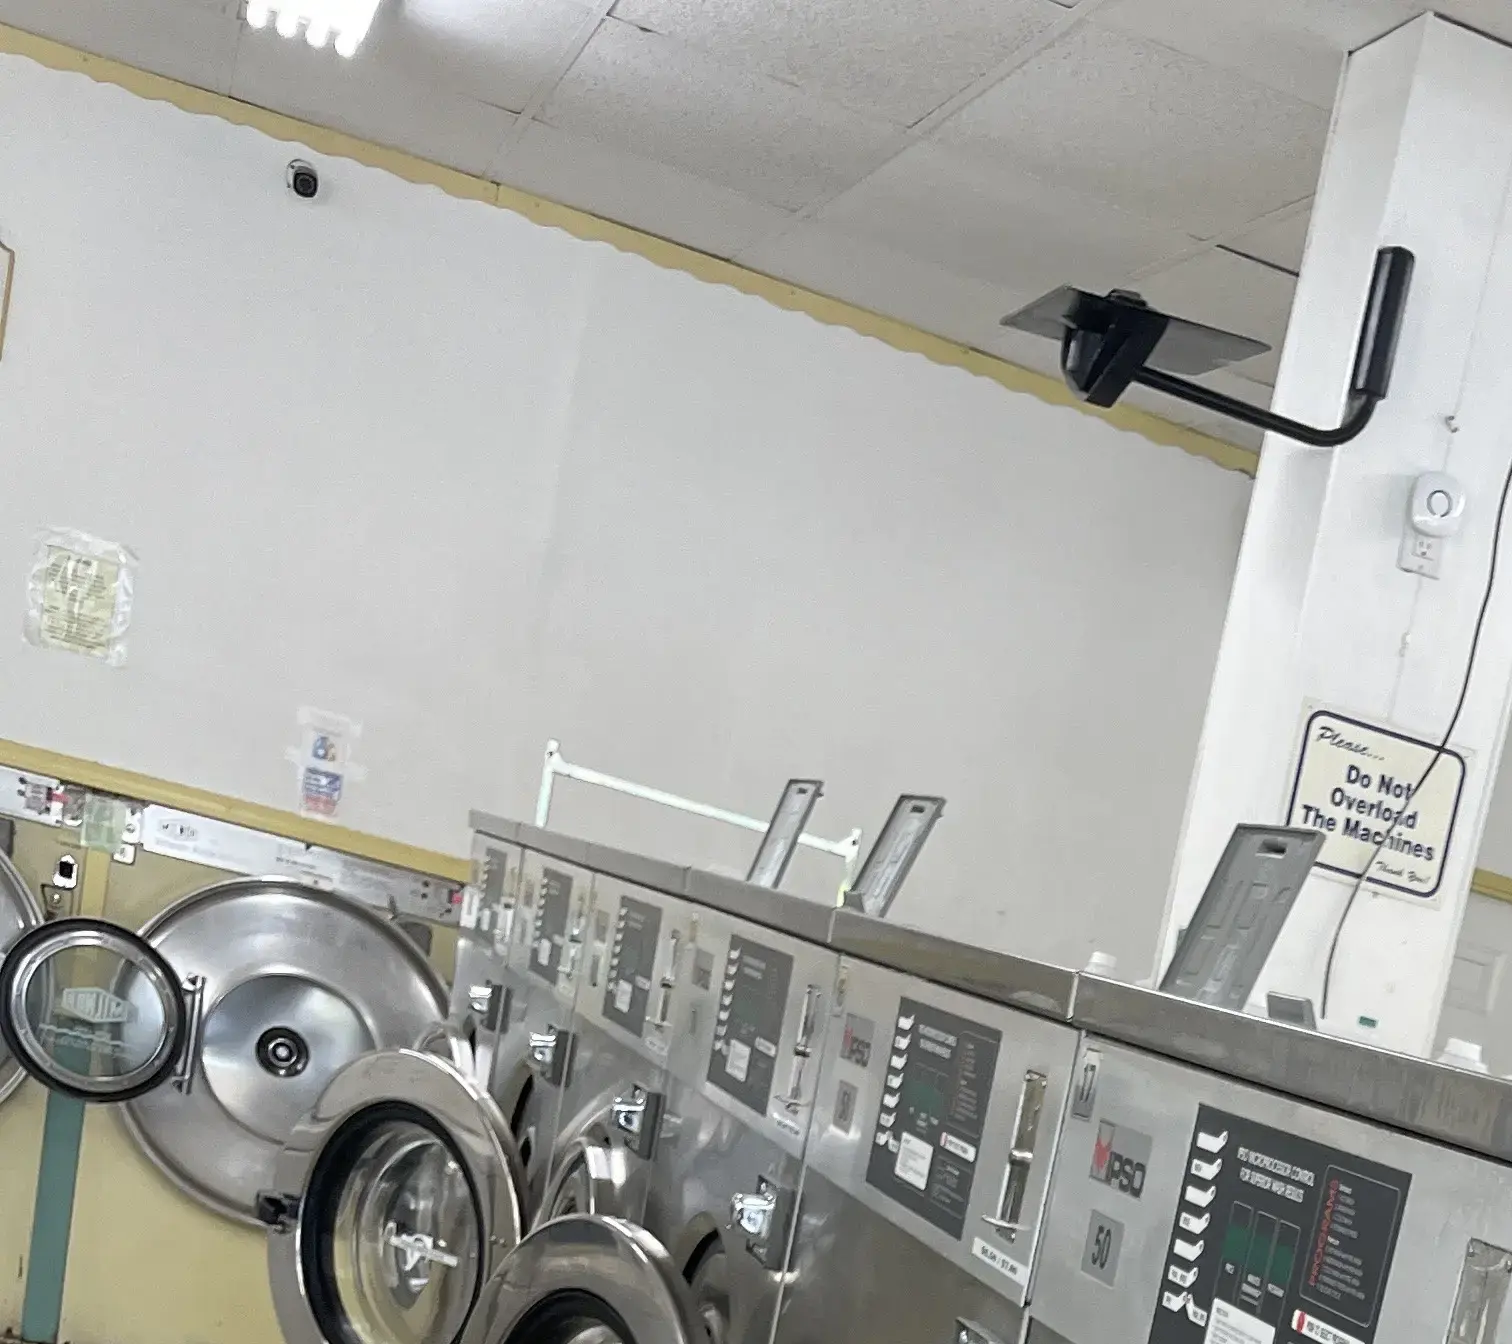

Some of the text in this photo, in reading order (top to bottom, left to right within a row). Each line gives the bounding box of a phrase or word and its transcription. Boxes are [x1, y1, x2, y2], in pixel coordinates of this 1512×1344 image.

[1346, 764, 1413, 800] Do Not
[1330, 787, 1418, 829] Overload
[1302, 804, 1435, 861] The Machines
[1108, 1151, 1146, 1199] IPSO
[1091, 1224, 1111, 1270] 50
